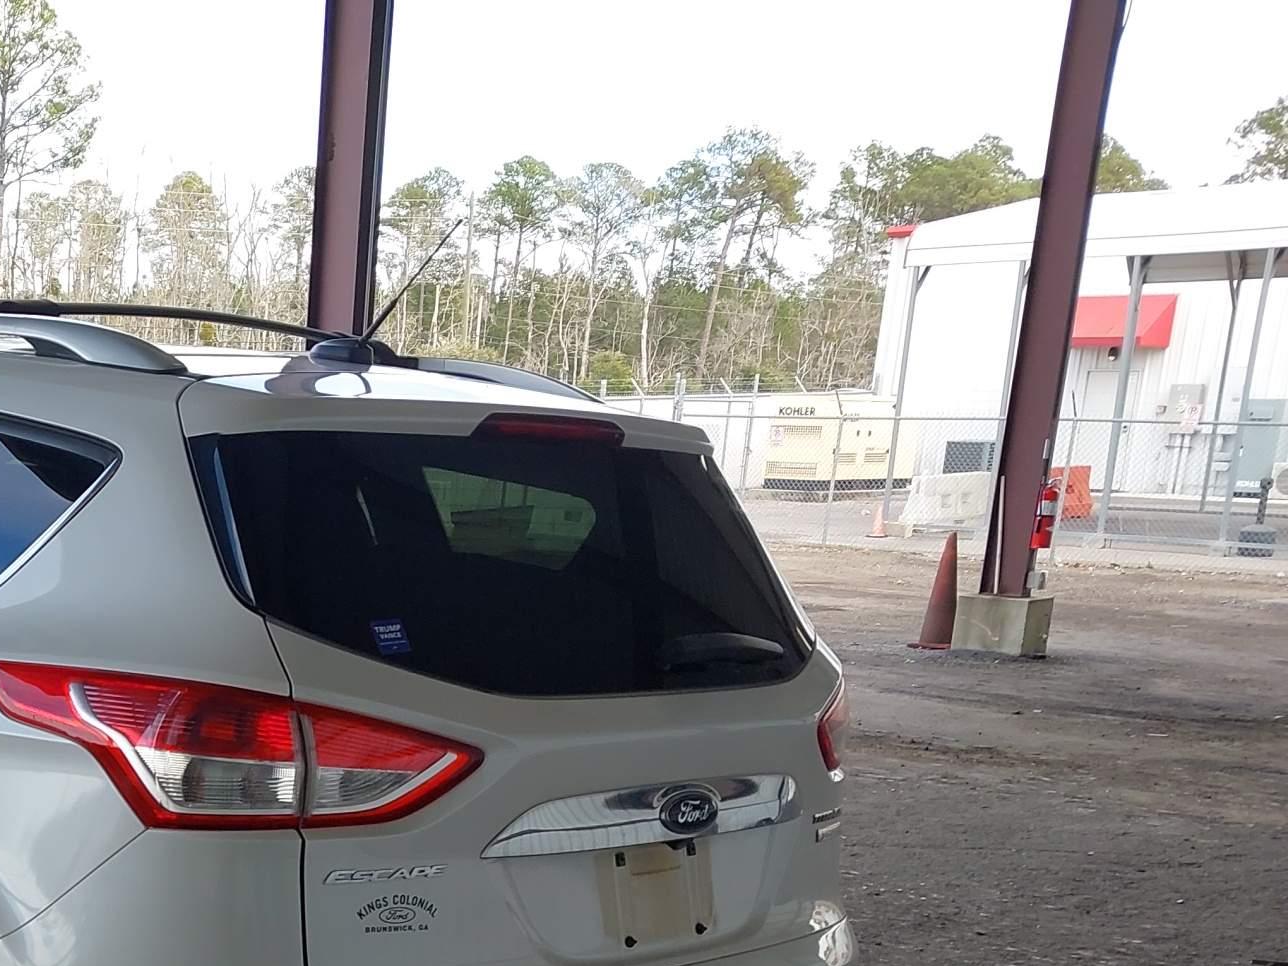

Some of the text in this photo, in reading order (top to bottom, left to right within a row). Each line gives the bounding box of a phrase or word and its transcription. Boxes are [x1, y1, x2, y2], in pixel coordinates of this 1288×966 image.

[778, 406, 816, 416] KOHLER
[678, 800, 710, 824] Ford
[322, 864, 449, 885] ESCAPE
[356, 895, 438, 920] KINGS COLONIAL
[385, 909, 410, 921] Ford
[364, 925, 416, 933] BRUNSWICK,
